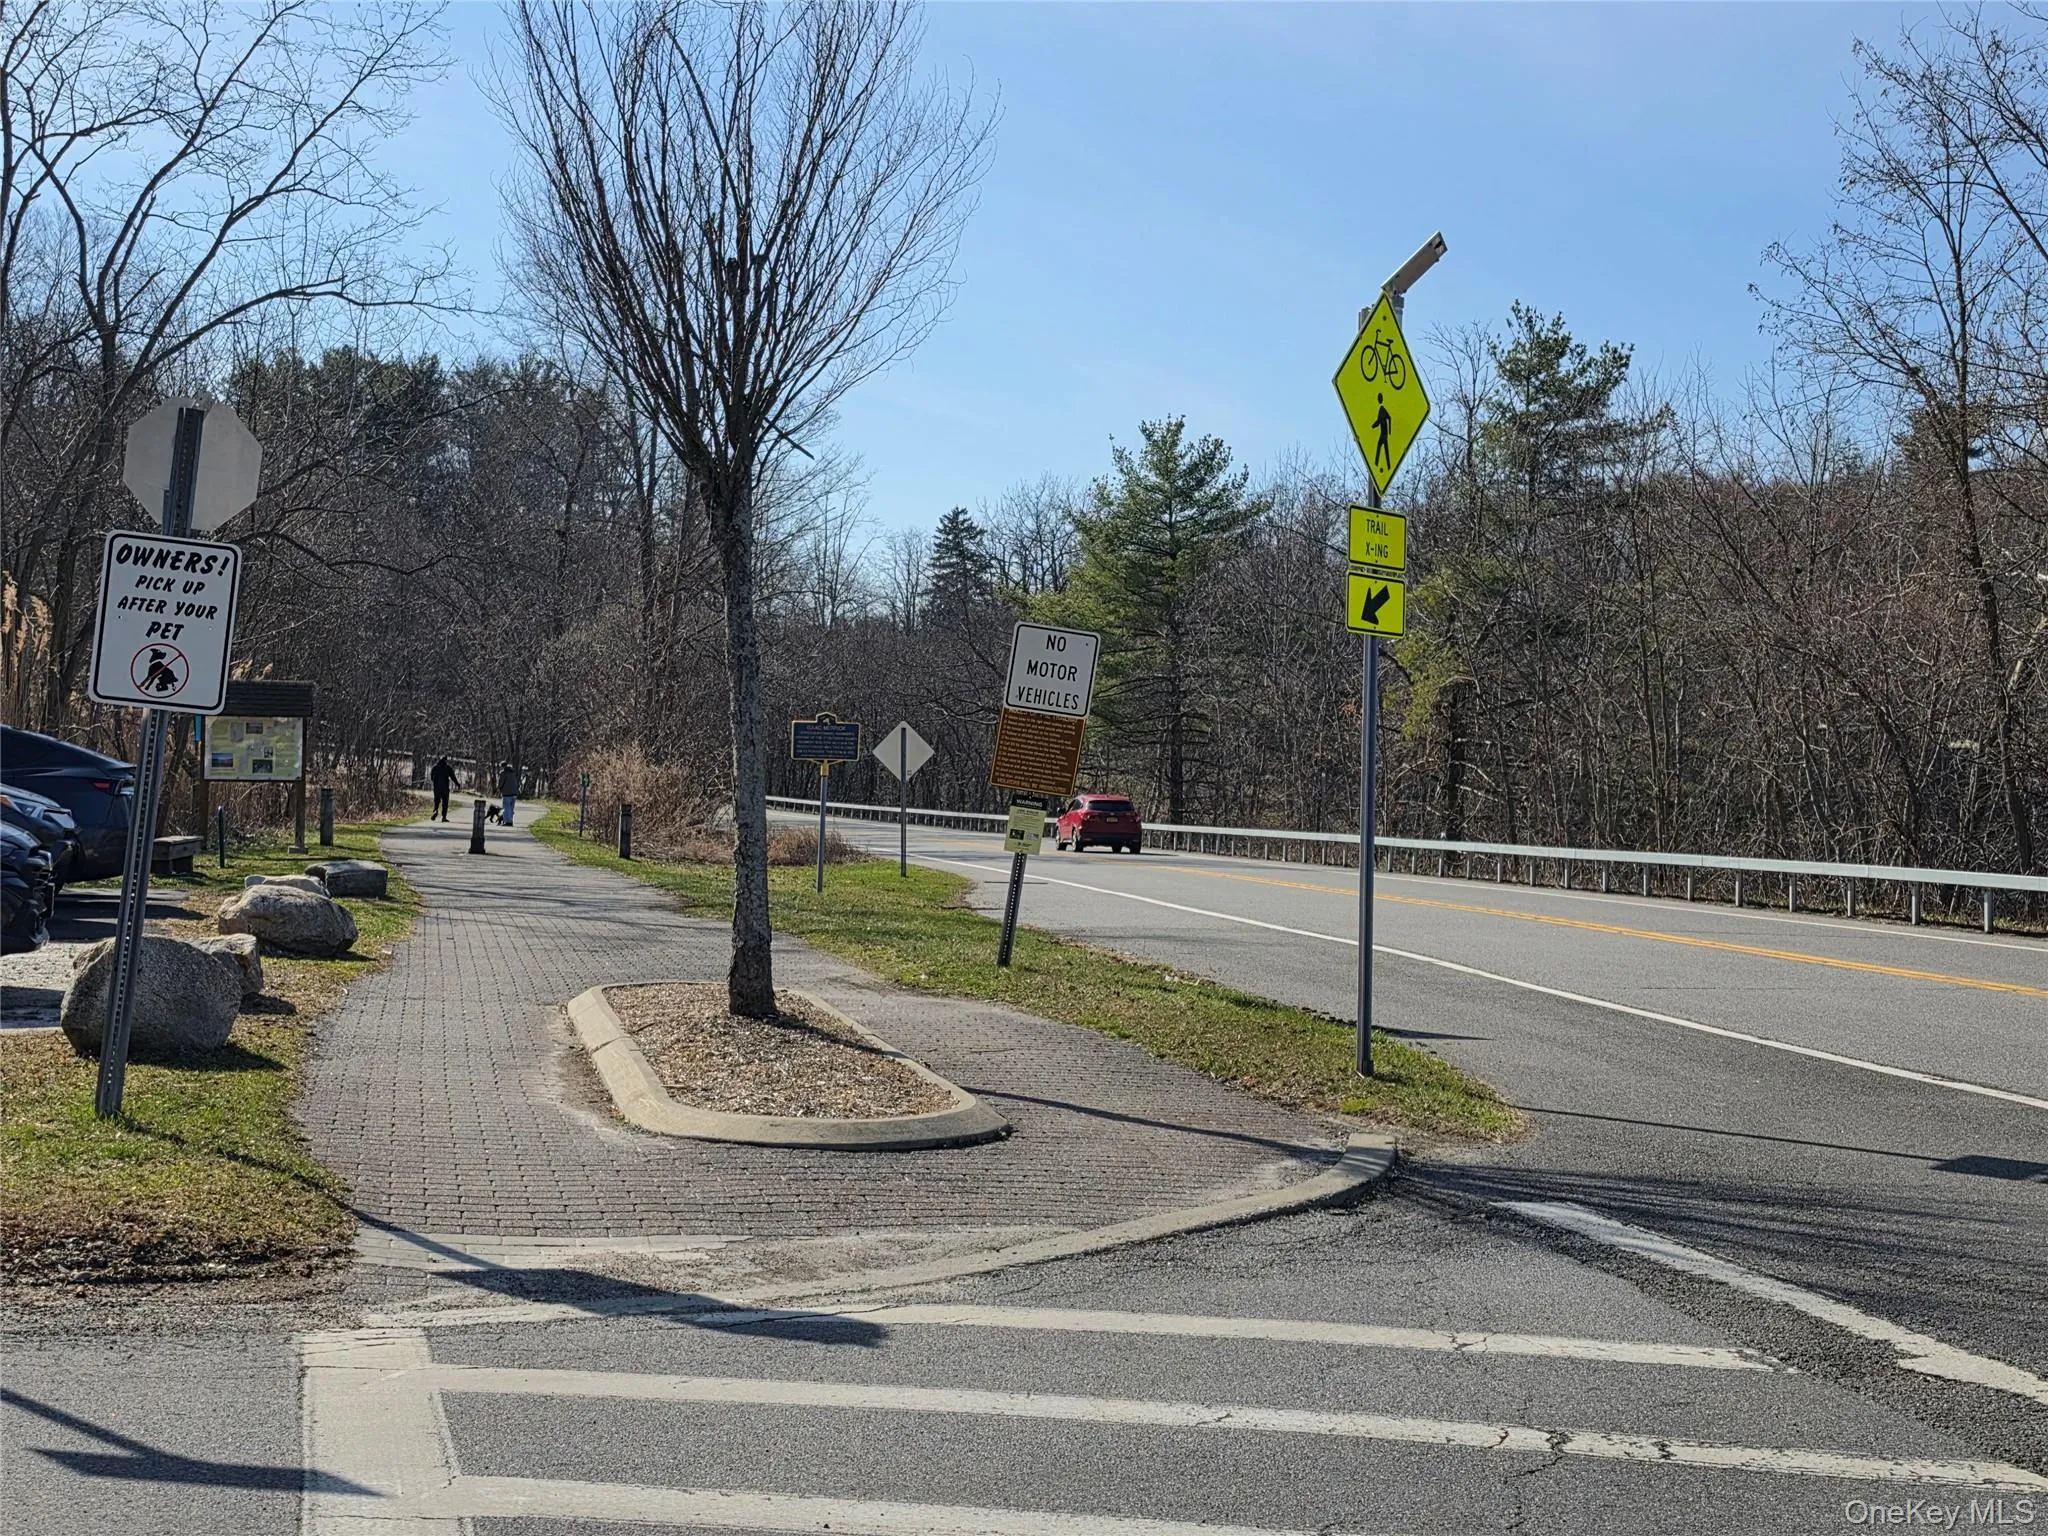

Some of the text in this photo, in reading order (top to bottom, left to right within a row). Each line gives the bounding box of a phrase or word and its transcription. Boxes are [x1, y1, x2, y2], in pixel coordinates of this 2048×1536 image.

[1366, 518, 1389, 536] TRAIL
[116, 543, 230, 577] OWNERS!
[1365, 541, 1389, 559] X-ING
[135, 575, 206, 595] PICK UP
[117, 595, 218, 620] AFTER YOUR
[145, 621, 185, 641] PET
[1046, 634, 1067, 652] NO
[1026, 659, 1078, 682] MOTOR
[1018, 686, 1080, 710] VEHICLES
[1016, 799, 1043, 808] WARNING
